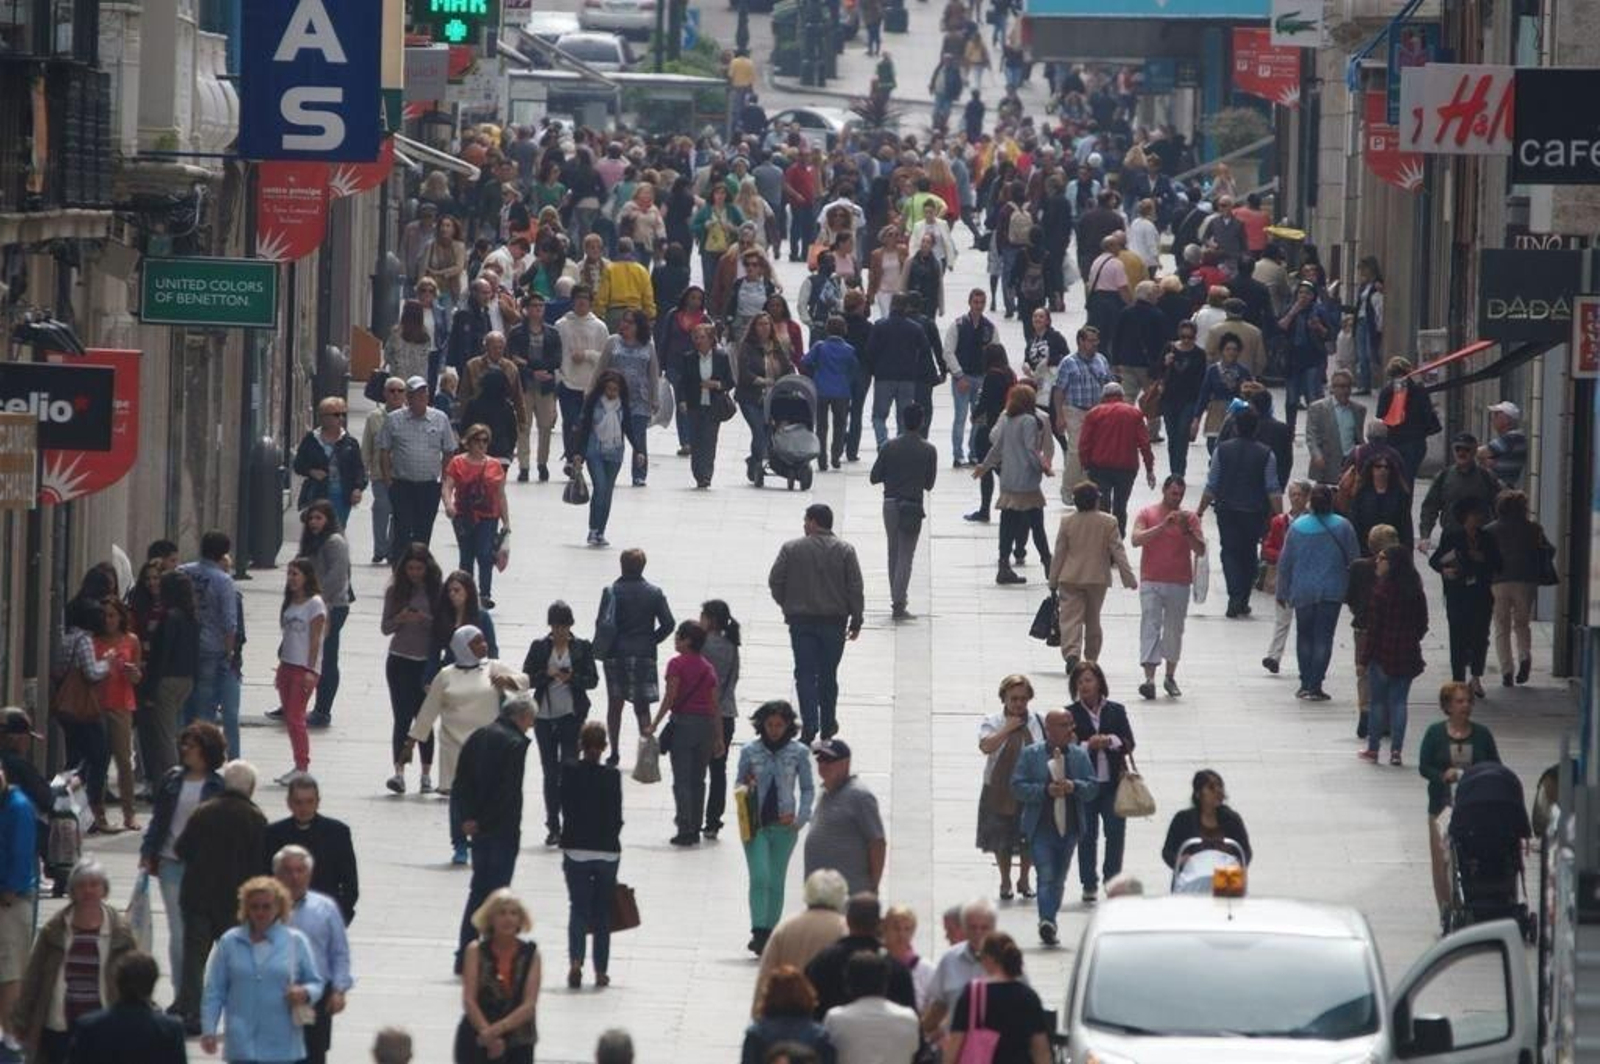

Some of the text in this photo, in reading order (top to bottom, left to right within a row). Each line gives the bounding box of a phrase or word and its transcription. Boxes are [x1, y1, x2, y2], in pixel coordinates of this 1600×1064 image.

[155, 278, 263, 293] UNITED COLORS
[154, 291, 173, 303] OF
